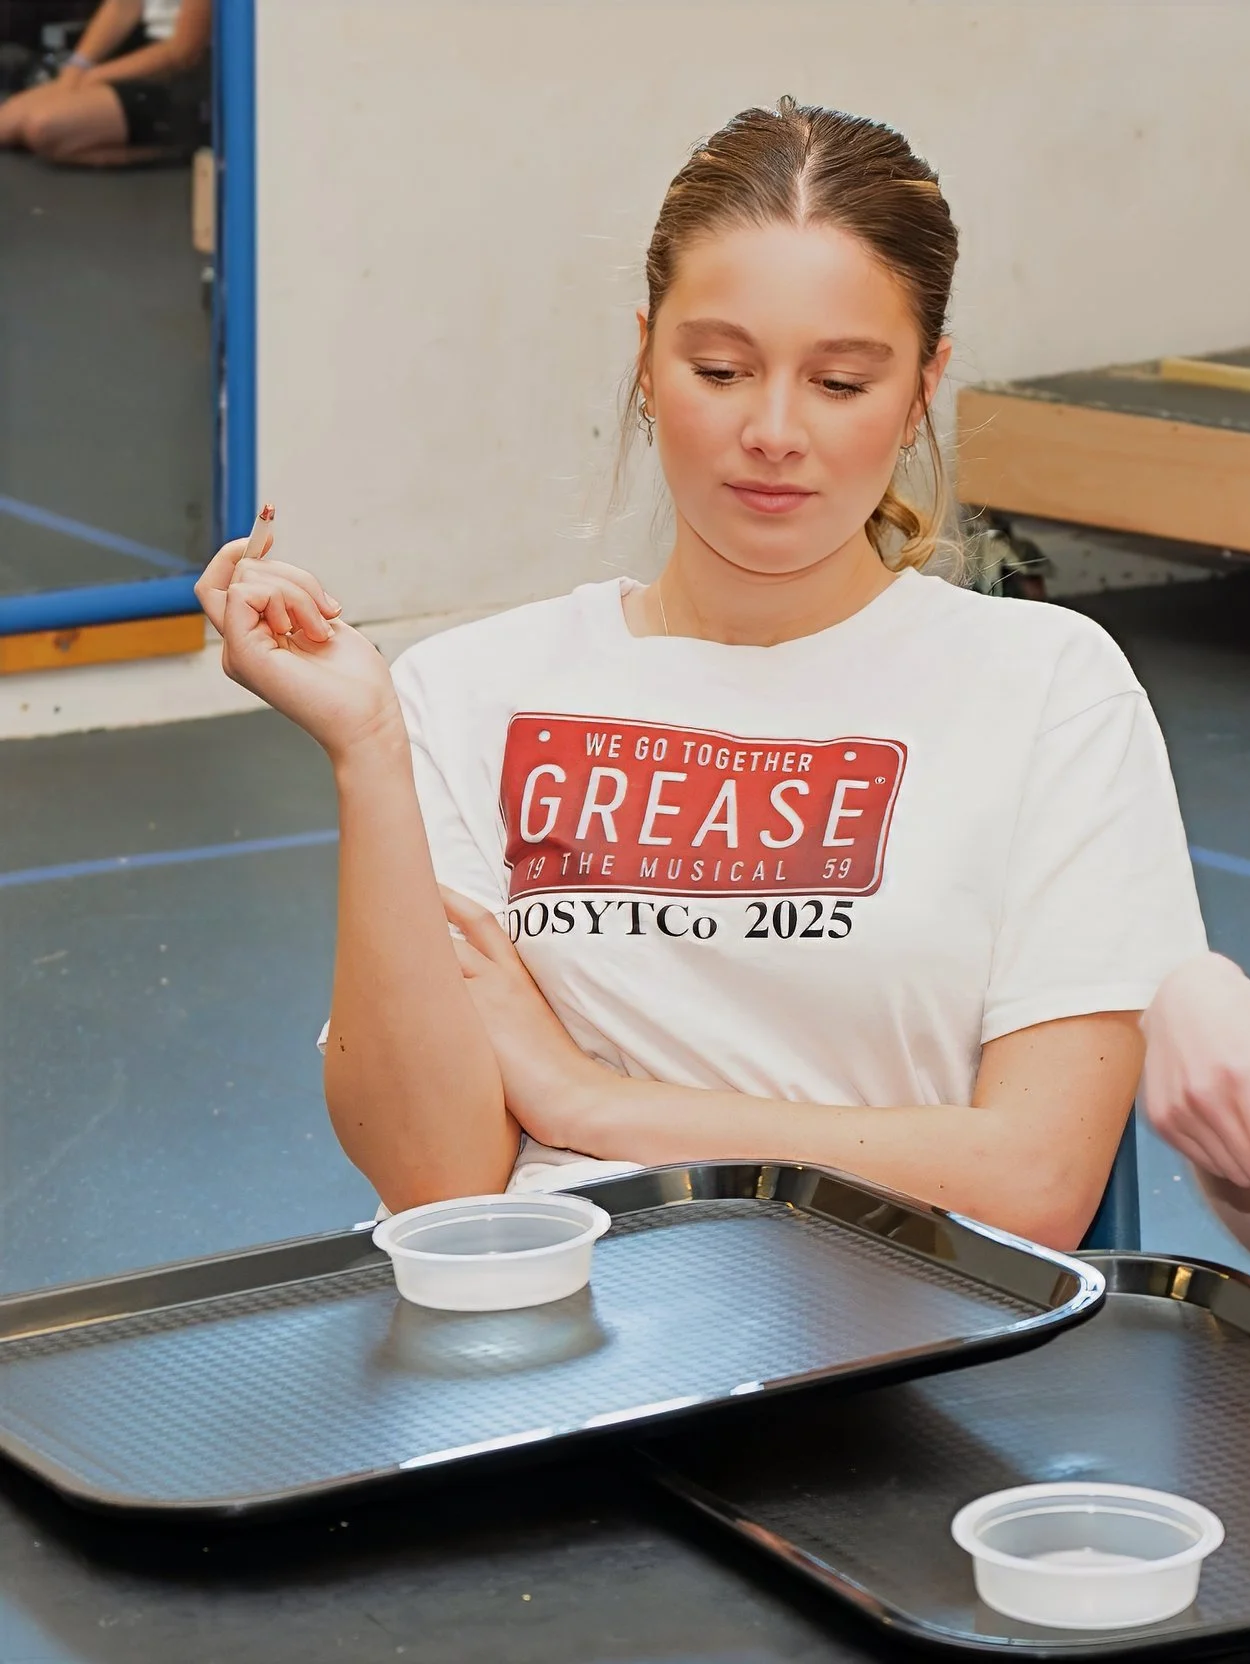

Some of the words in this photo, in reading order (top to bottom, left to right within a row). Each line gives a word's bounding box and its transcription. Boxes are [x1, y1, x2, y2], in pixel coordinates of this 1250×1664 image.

[586, 732, 622, 758] WE
[634, 736, 669, 762] GO
[683, 741, 813, 773] TOGETHER
[519, 763, 870, 849] GREASE
[526, 855, 546, 881] 19
[560, 852, 616, 877] THE
[639, 857, 787, 883] MUSICAL
[822, 857, 852, 880] 59
[744, 900, 855, 940] 2025
